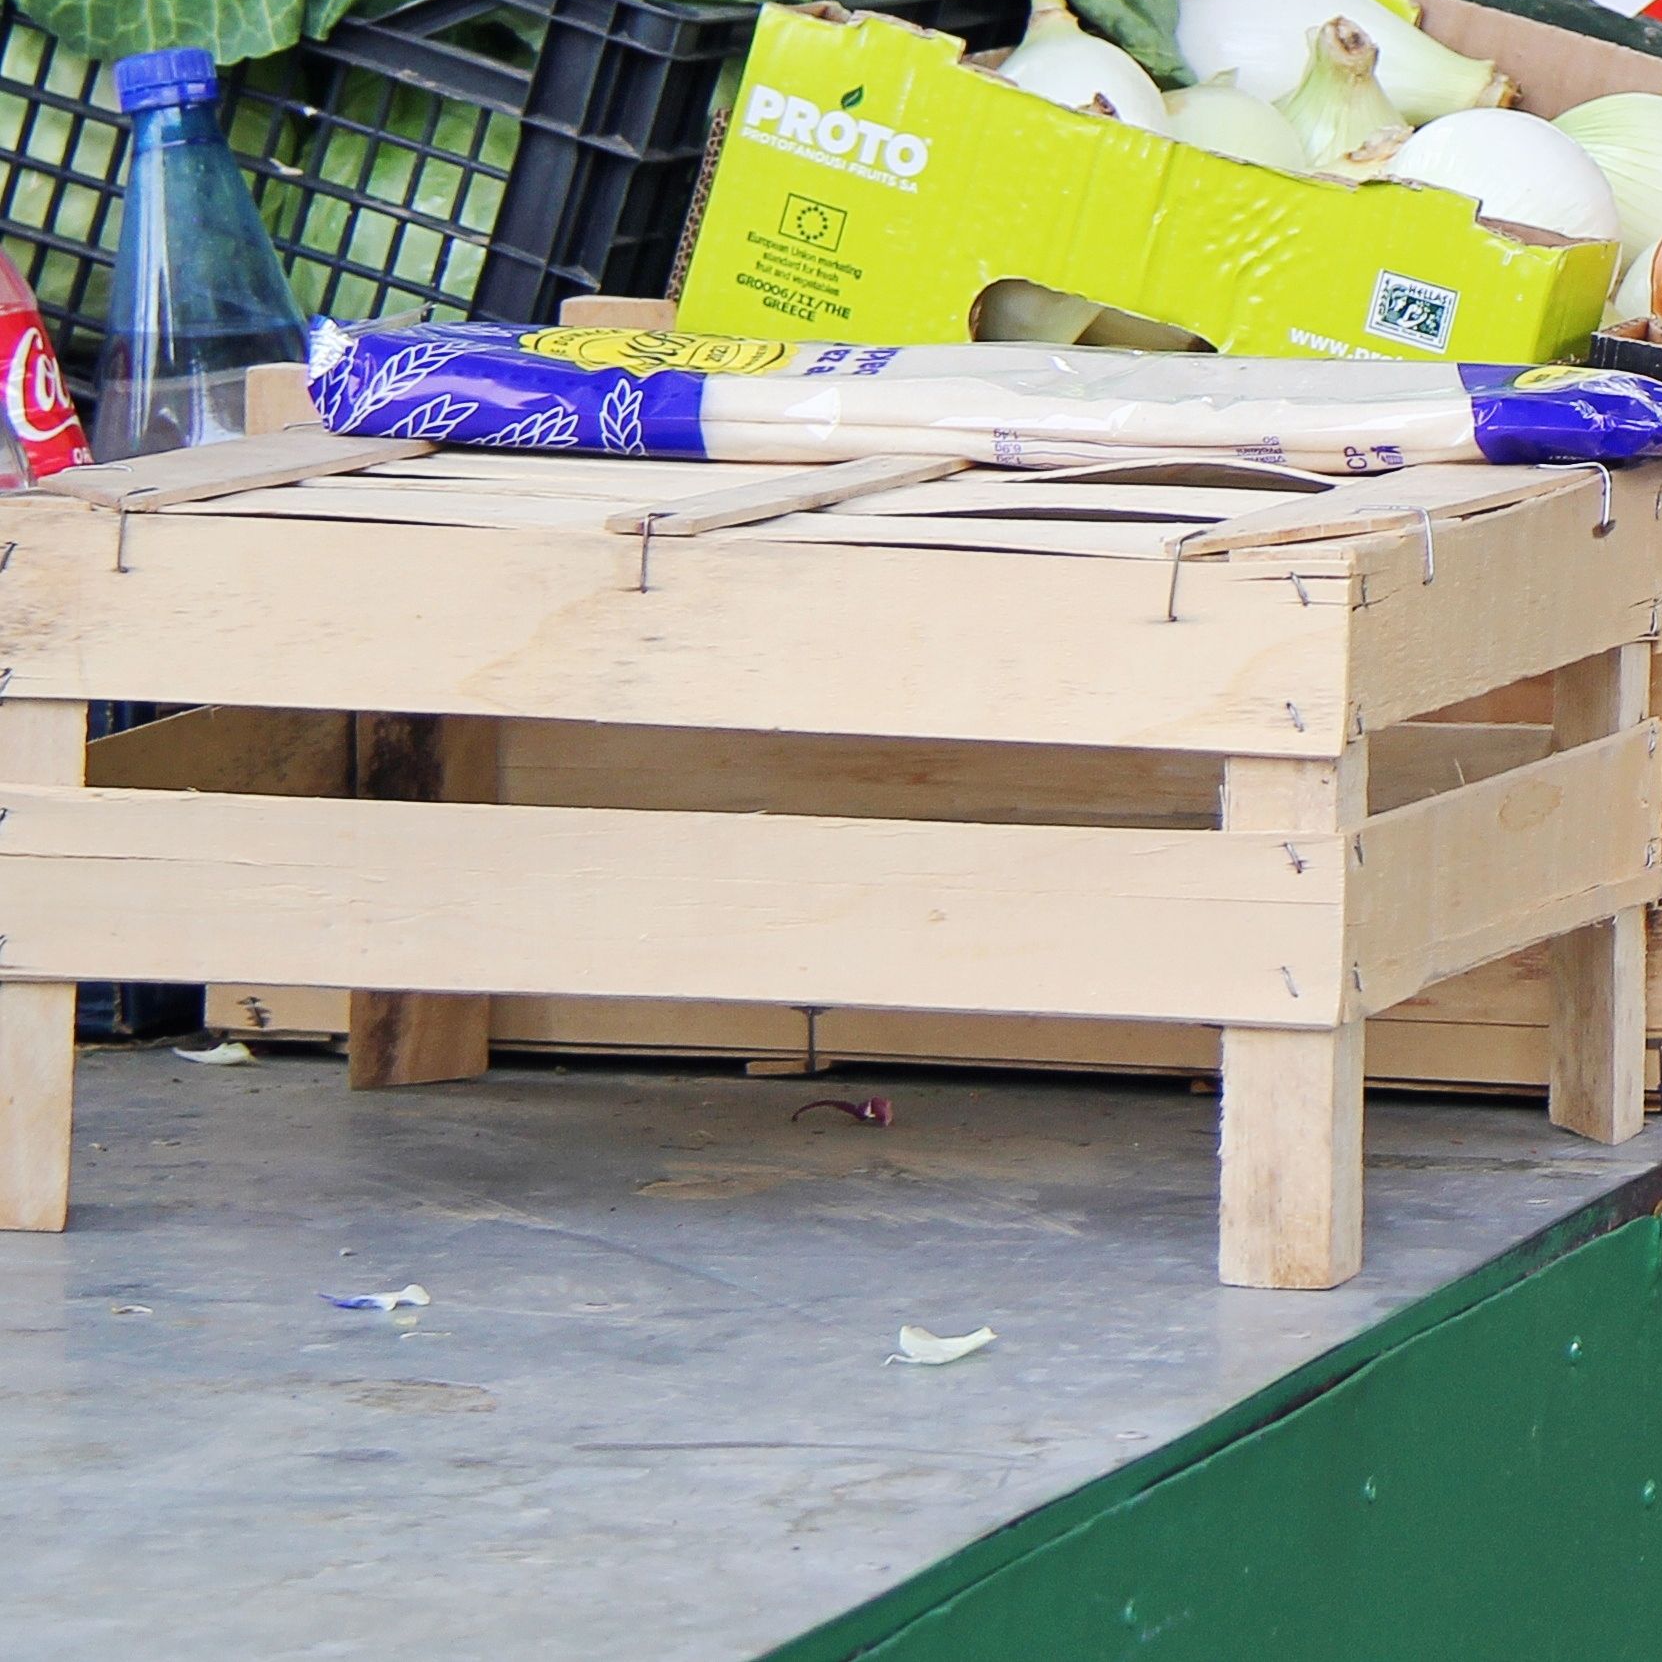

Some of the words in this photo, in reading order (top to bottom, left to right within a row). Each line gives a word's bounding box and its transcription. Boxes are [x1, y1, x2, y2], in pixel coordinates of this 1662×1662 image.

[744, 84, 928, 177] PROTO
[849, 161, 897, 188] FRUITS
[747, 230, 789, 252] European
[791, 244, 816, 262] Union
[818, 257, 862, 279] marketing
[763, 252, 801, 270] standard
[802, 264, 814, 275] for
[816, 267, 839, 282] fresh
[755, 260, 773, 274] fruit
[774, 268, 791, 280] and
[793, 275, 840, 296] vegetables
[763, 295, 816, 322] GREECE
[1408, 284, 1449, 305] HELLAS
